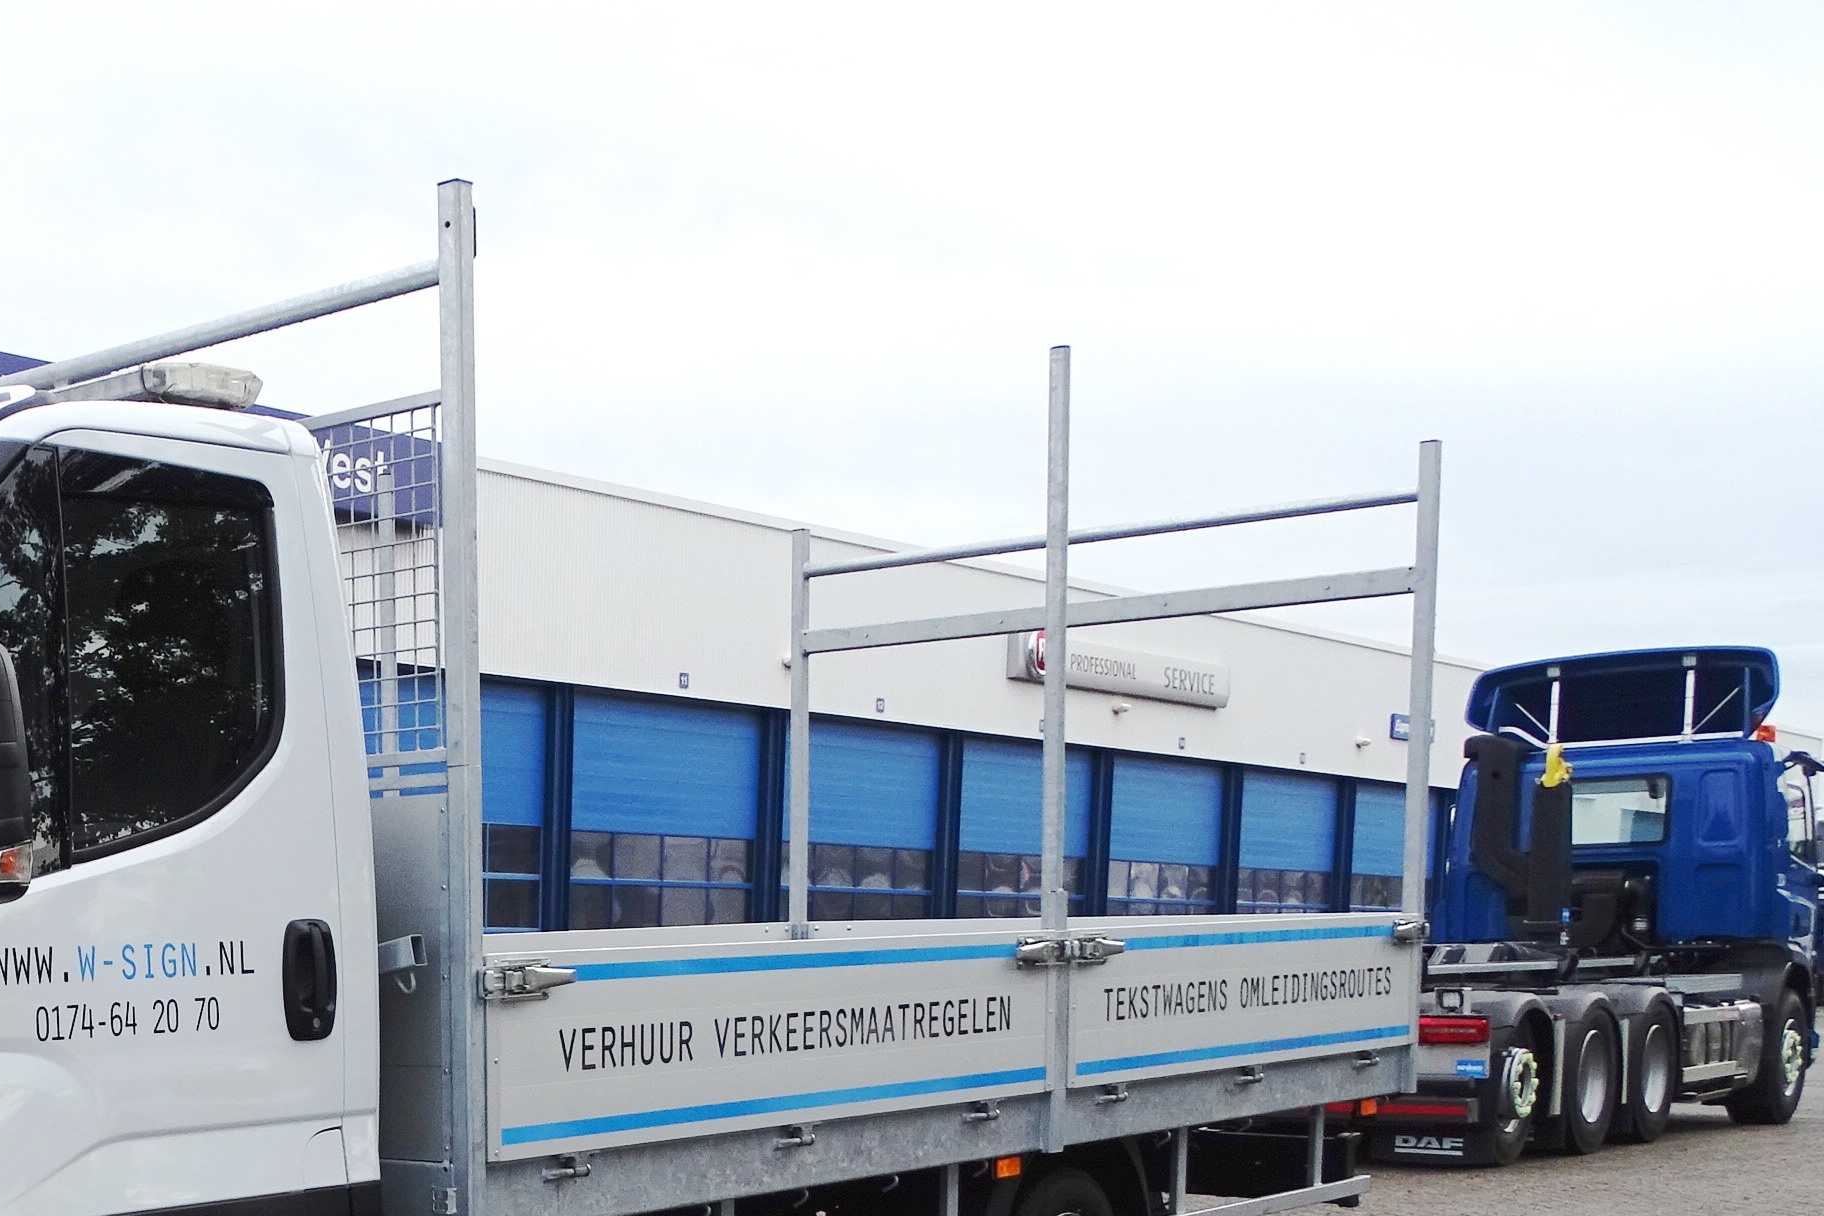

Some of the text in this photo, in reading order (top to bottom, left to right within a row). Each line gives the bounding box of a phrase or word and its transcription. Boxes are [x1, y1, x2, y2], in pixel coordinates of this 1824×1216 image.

[322, 439, 390, 493] est
[1070, 653, 1215, 695] PROFESSIONAL SERVICE
[35, 996, 220, 1042] 0174-64 20 70
[1104, 966, 1392, 1022] TEKSTWAGENS OMLEIDINGSROUTES
[558, 995, 1011, 1073] VERHUUR VERKEERSMAATREGELEN
[1395, 1135, 1463, 1149] DAF
